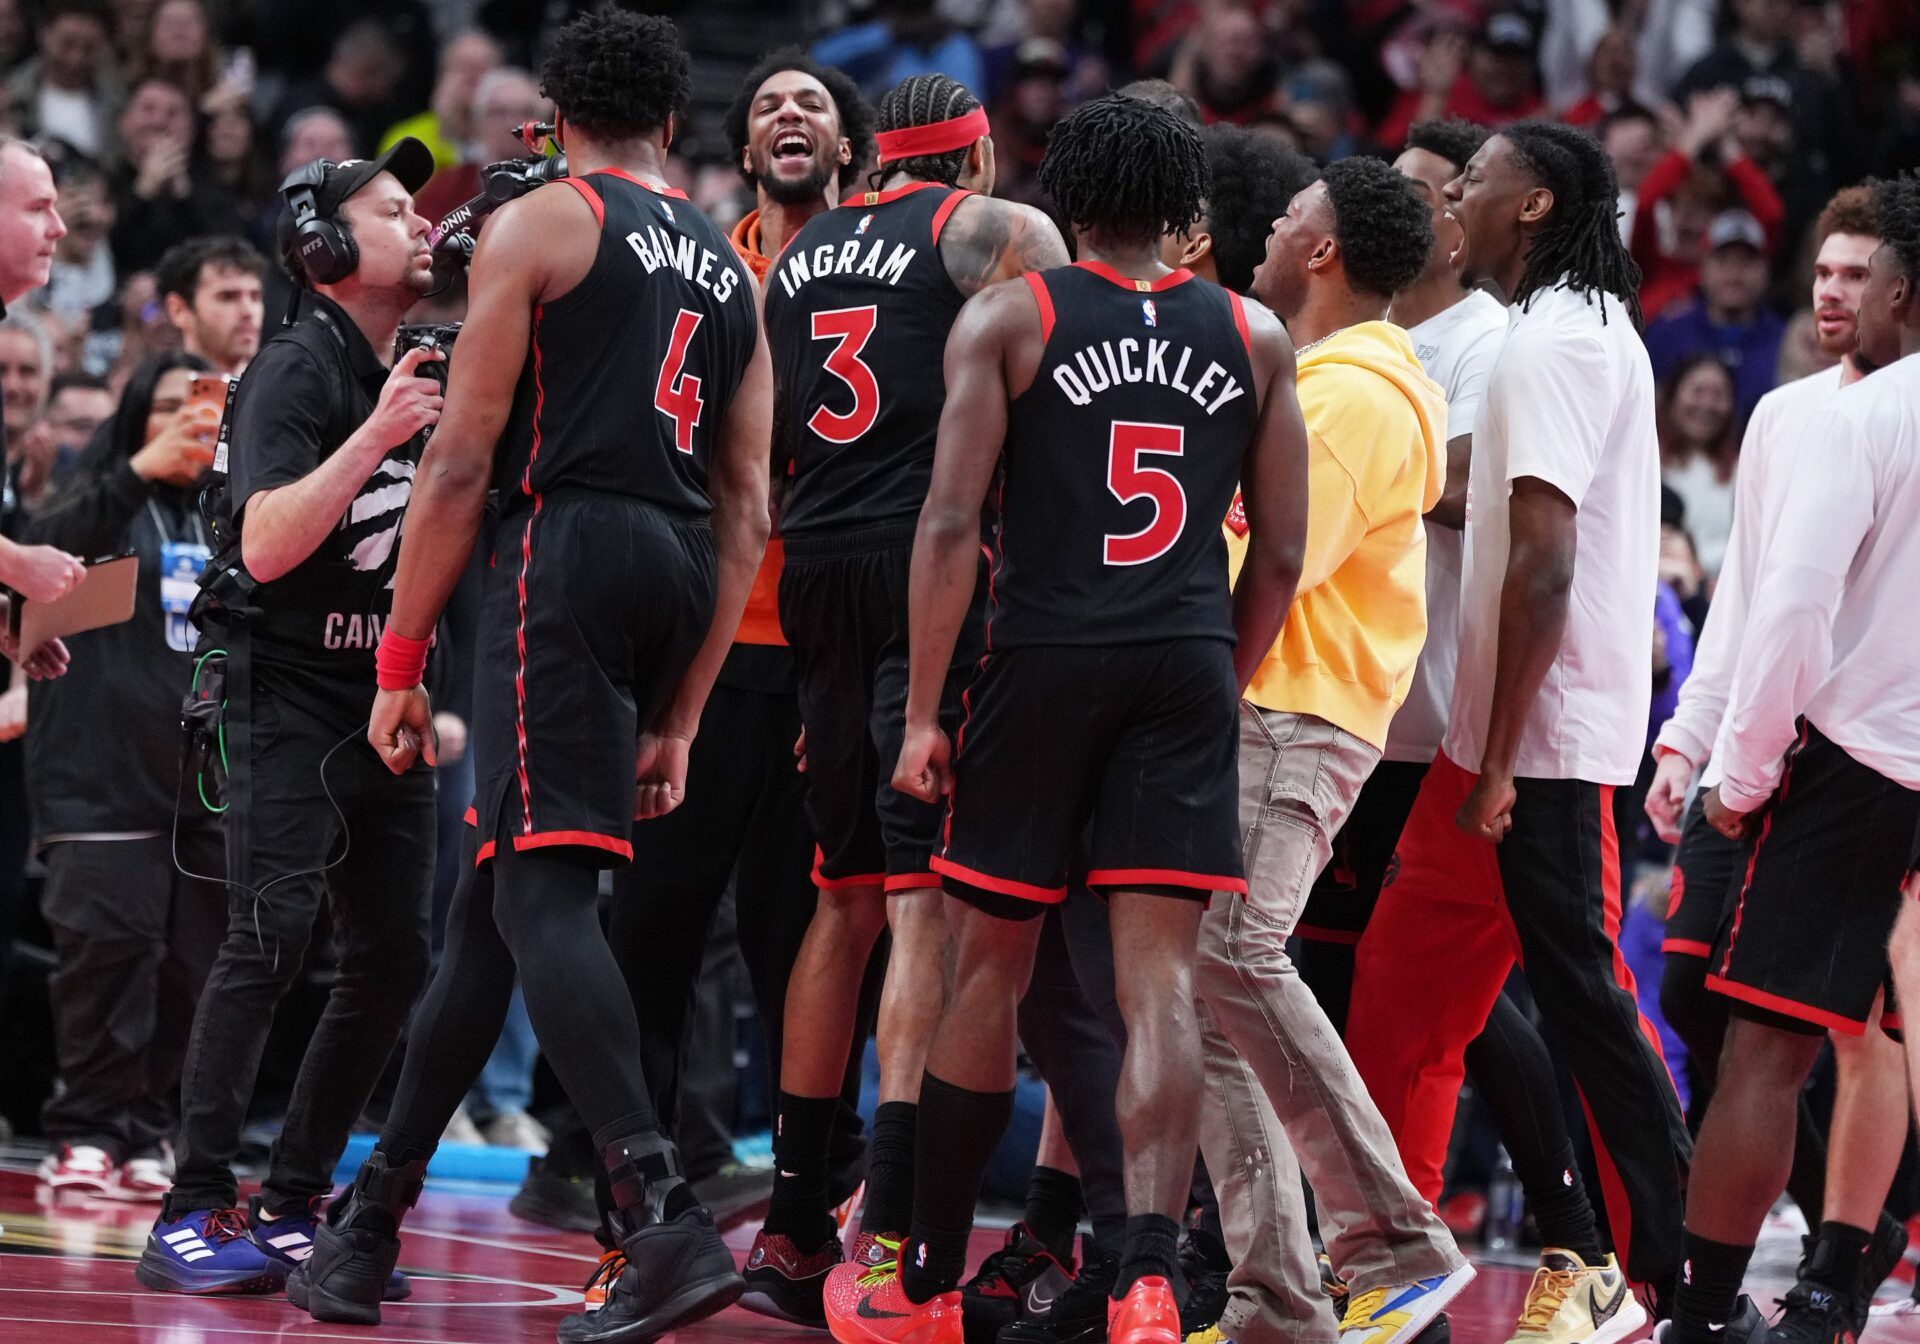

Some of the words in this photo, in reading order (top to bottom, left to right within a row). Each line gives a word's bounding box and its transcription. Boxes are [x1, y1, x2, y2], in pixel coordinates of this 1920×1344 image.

[302, 237, 323, 256] RTS
[625, 225, 739, 303] BARNES
[778, 239, 917, 299] INGRAM
[655, 308, 704, 455] 4
[806, 304, 880, 444] 3
[1053, 338, 1245, 416] QUICKLEY
[1103, 420, 1188, 566] 5
